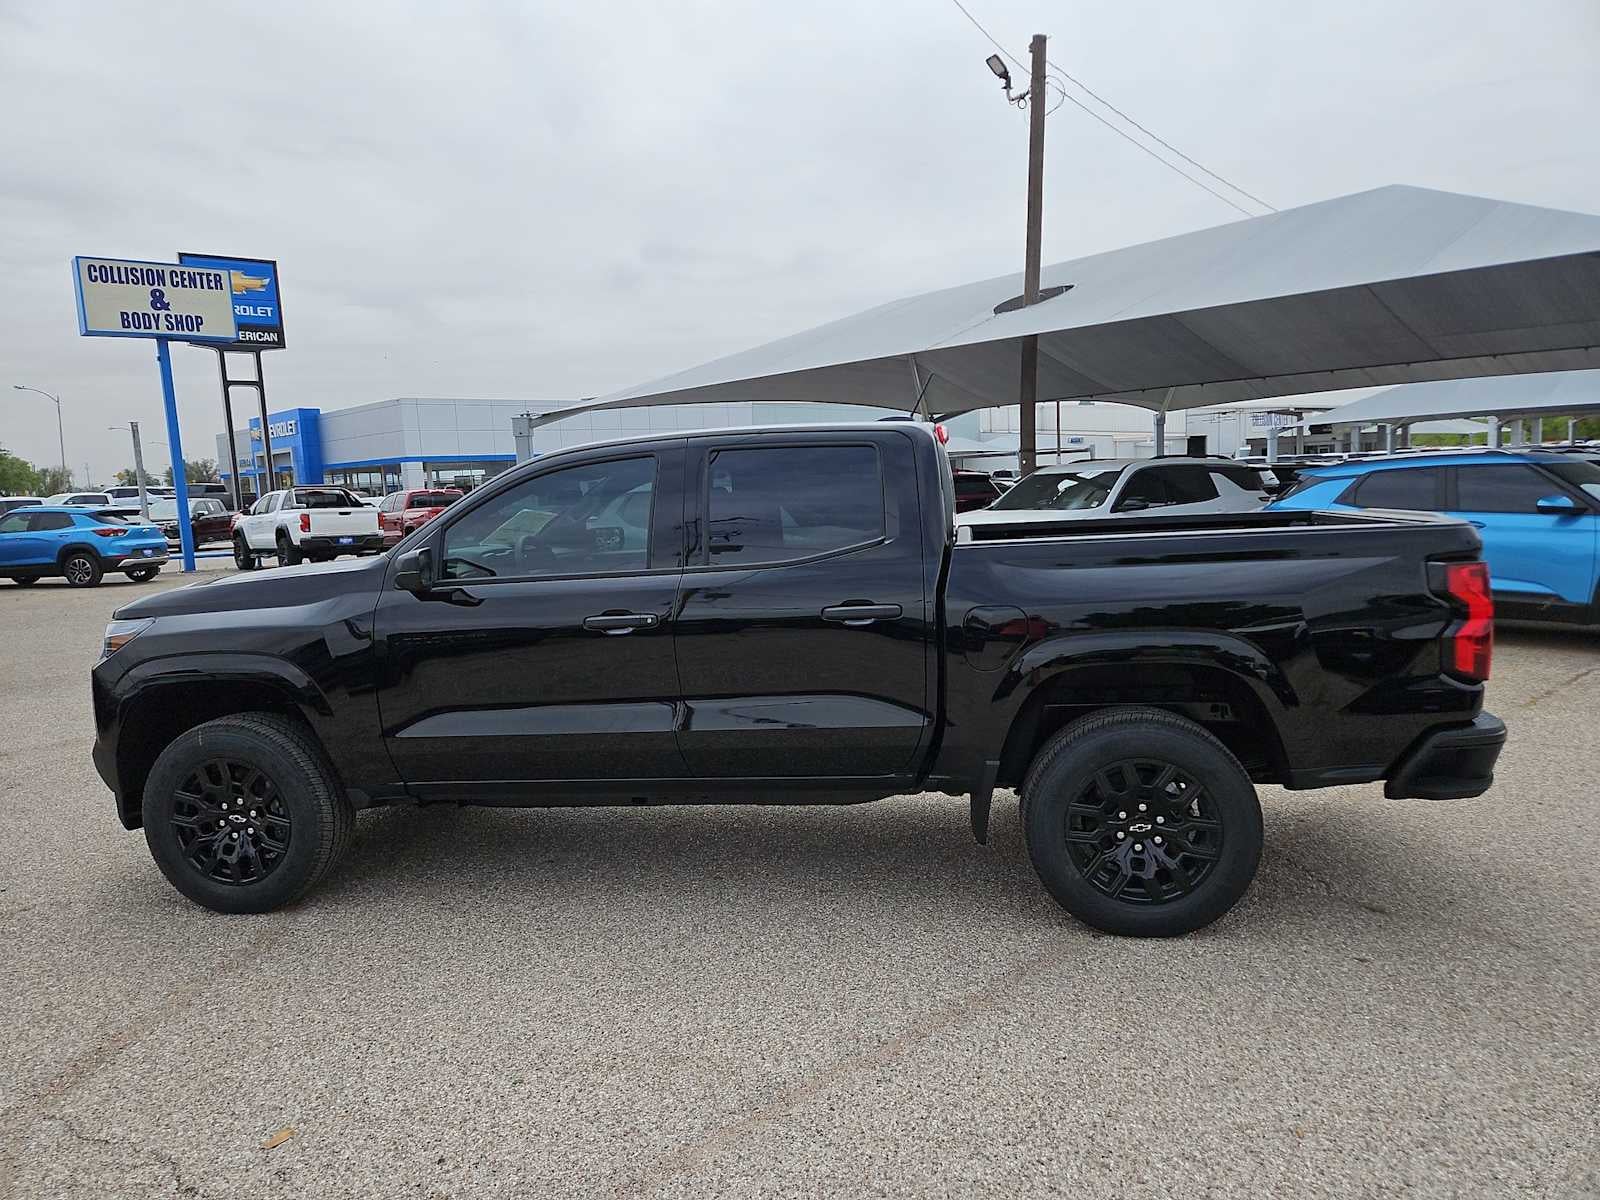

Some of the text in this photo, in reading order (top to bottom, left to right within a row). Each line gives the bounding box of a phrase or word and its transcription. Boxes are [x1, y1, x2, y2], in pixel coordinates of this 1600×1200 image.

[87, 264, 223, 290] COLLISION CENTER
[150, 288, 171, 311] &
[120, 311, 204, 332] BODY SHOP
[234, 305, 273, 317] ROLET
[239, 331, 278, 342] ERICAN
